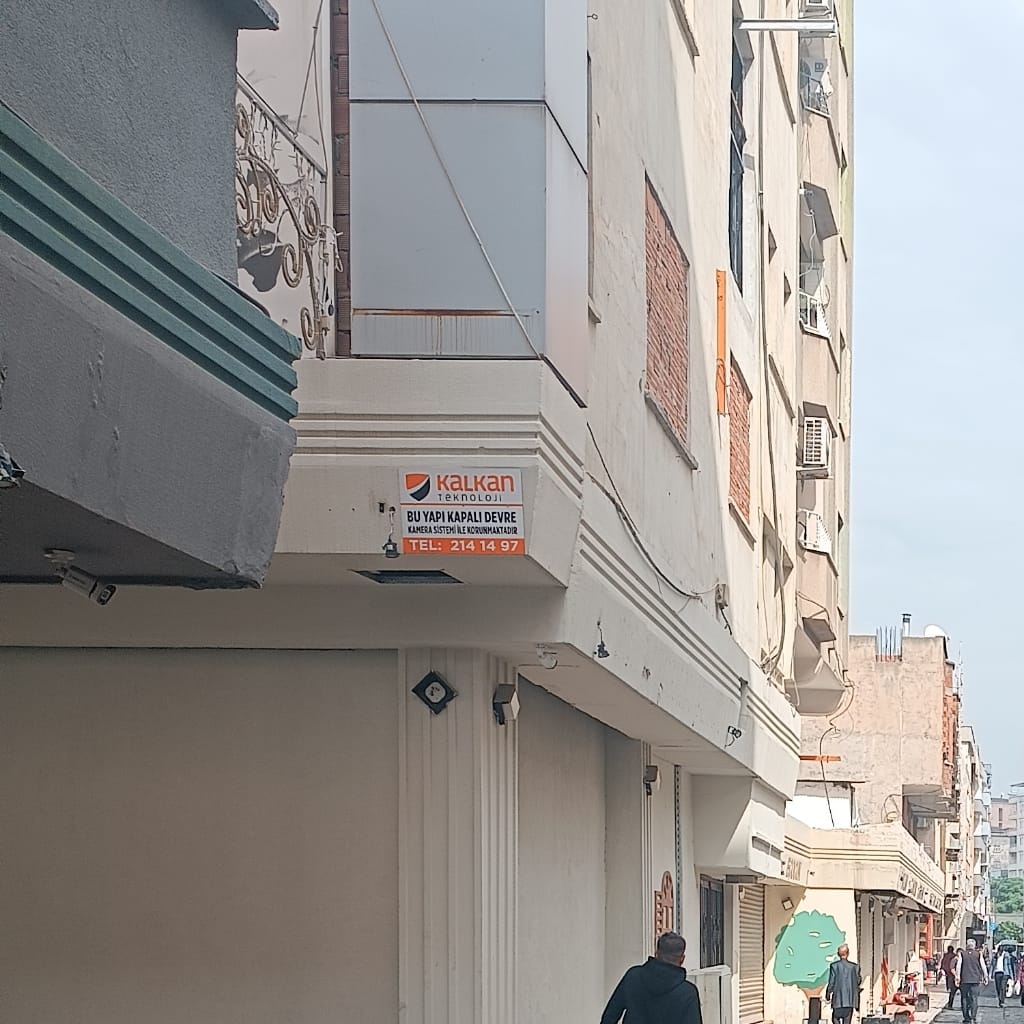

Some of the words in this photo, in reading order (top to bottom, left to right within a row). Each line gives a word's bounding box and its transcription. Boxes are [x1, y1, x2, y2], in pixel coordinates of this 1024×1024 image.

[407, 510, 420, 522] BU
[422, 511, 445, 522] YAPI
[447, 511, 482, 523] KAPALI
[484, 511, 516, 523] DEVRE
[408, 525, 432, 534] KAMERA
[467, 526, 518, 535] KORUNMAKTADIR
[409, 540, 442, 551] TEL:
[450, 540, 475, 551] 214
[480, 540, 496, 551] 14
[500, 540, 518, 551] 97
